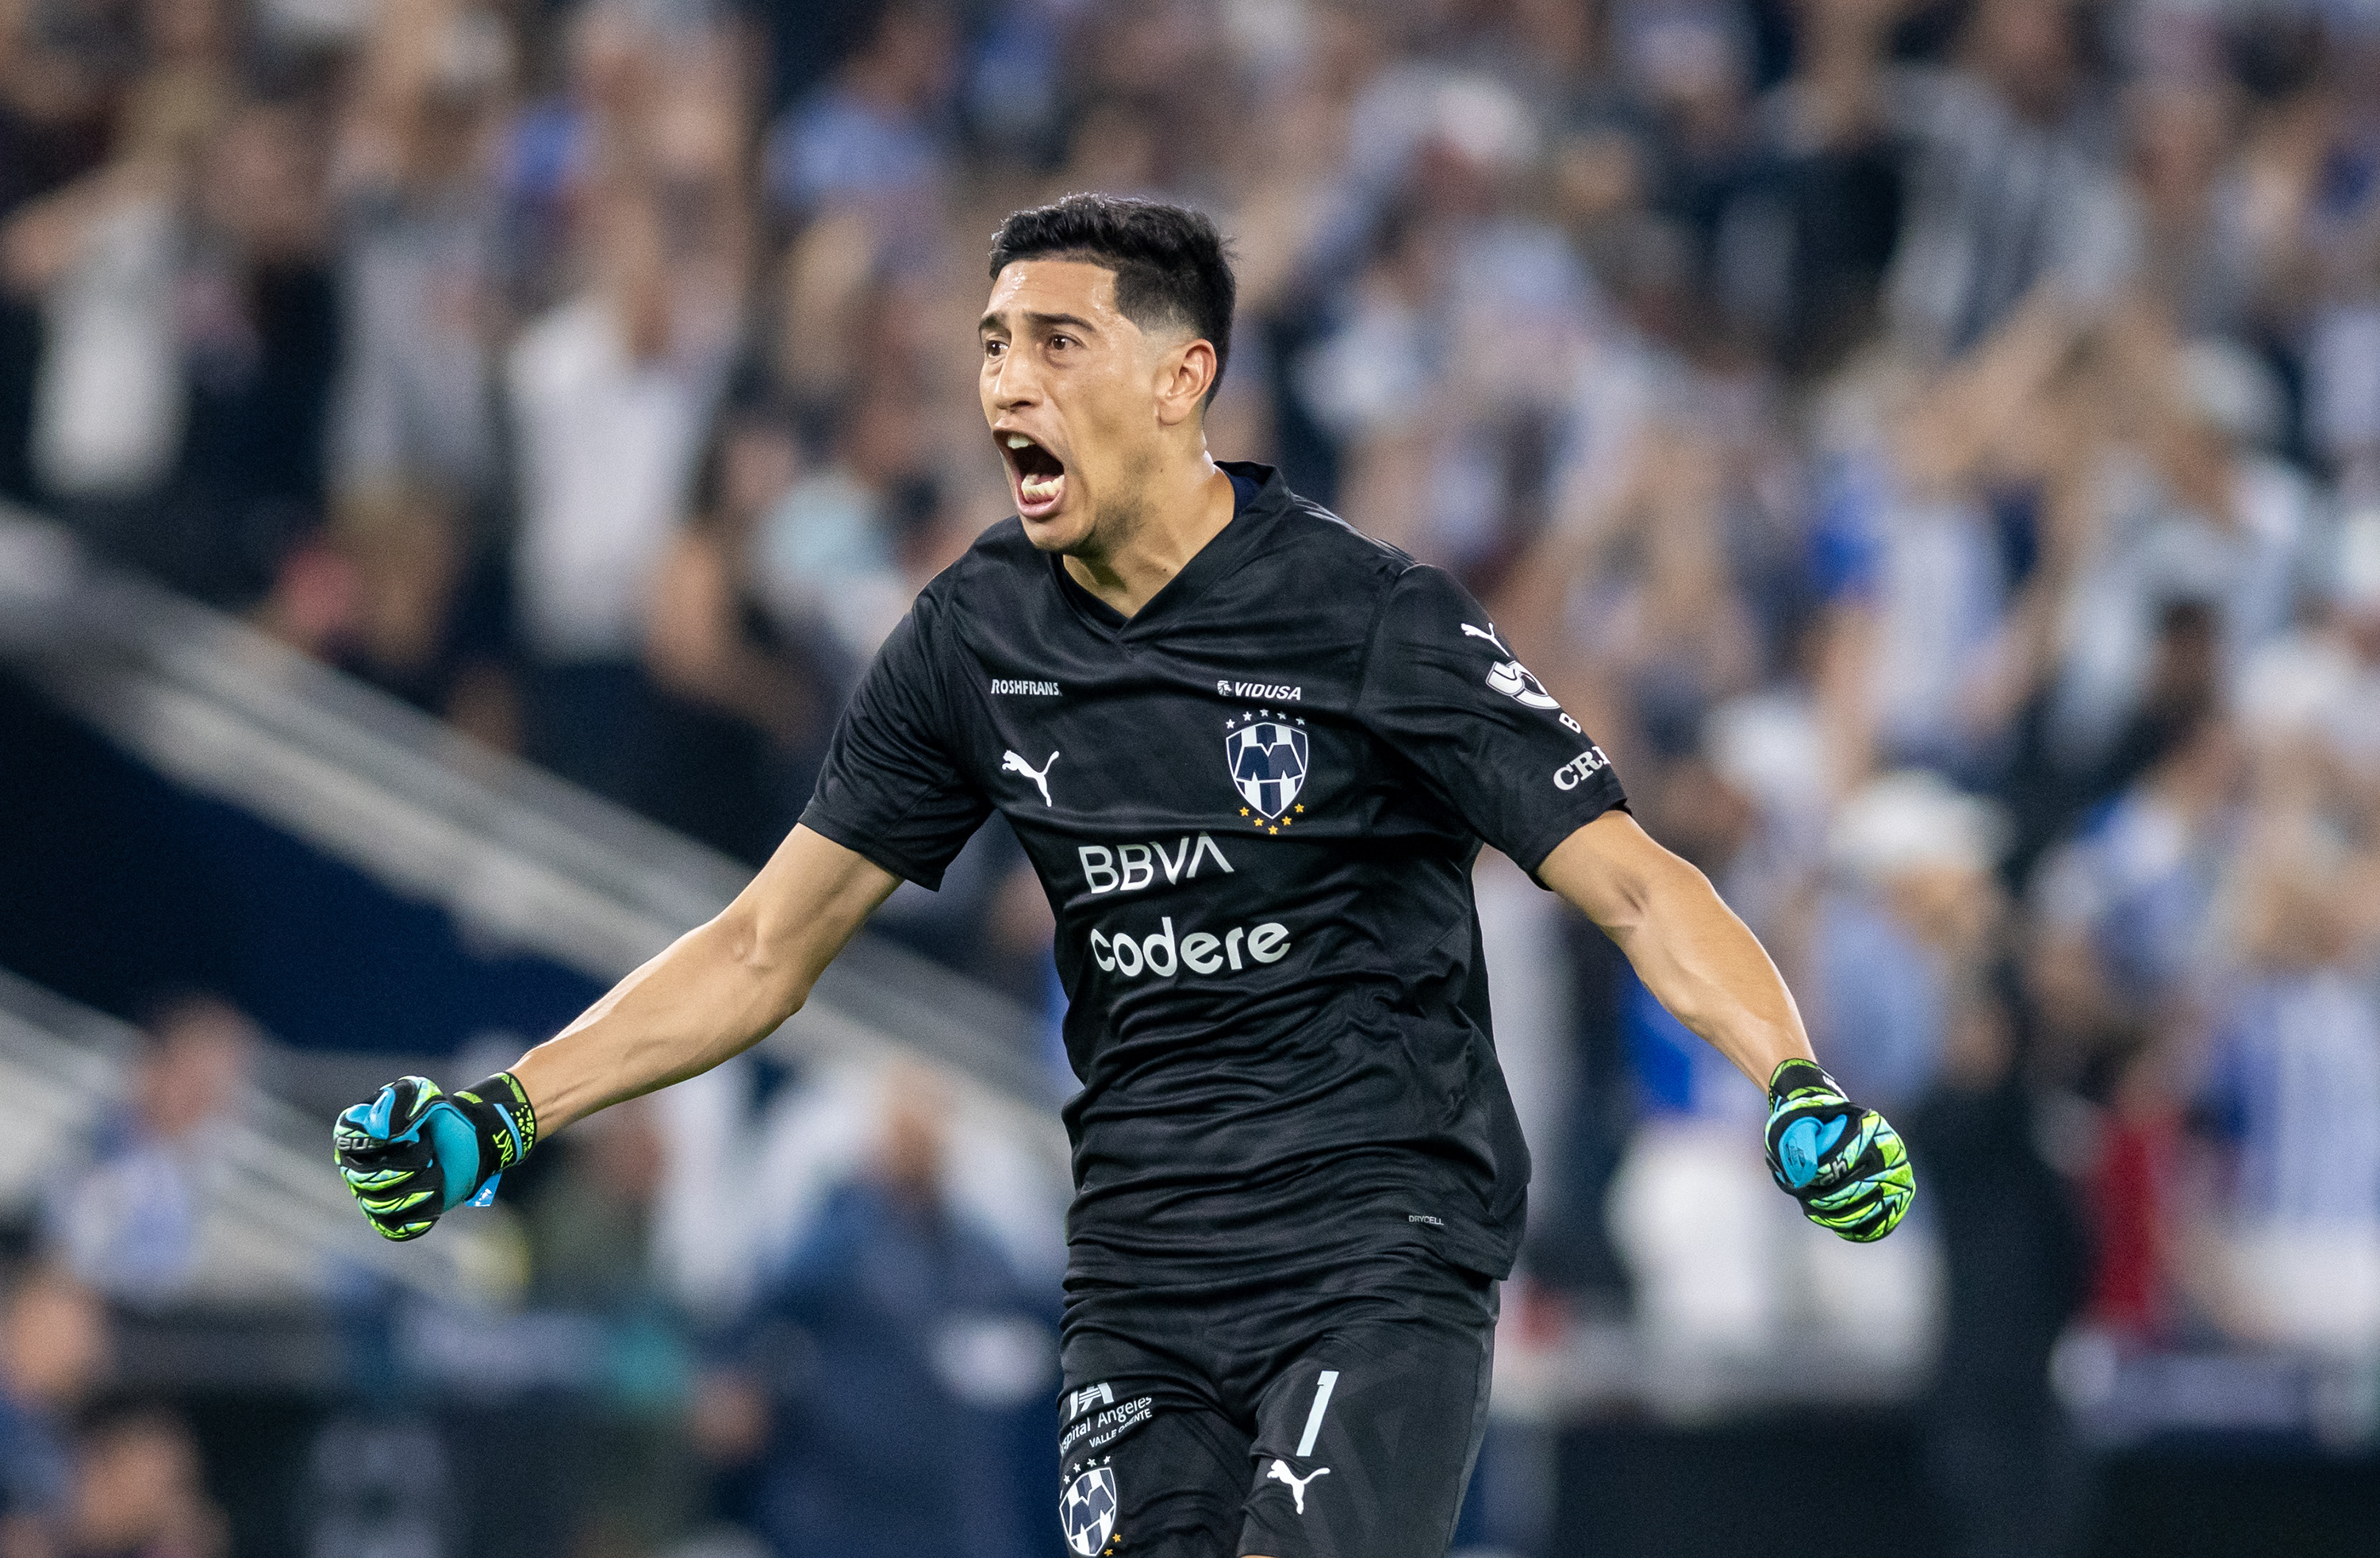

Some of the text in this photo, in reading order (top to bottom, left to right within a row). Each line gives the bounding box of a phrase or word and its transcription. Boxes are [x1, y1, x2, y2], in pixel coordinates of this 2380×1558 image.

[990, 678, 1060, 696] ROSHFRANS
[1234, 681, 1301, 700] VIDUSA
[1077, 831, 1235, 894] BBVA
[1090, 916, 1292, 977] codere
[1408, 1215, 1444, 1226] DRYCELL
[1097, 1396, 1153, 1428] Angeles
[1296, 1370, 1340, 1457] 1
[1088, 1429, 1117, 1448] VALLE
